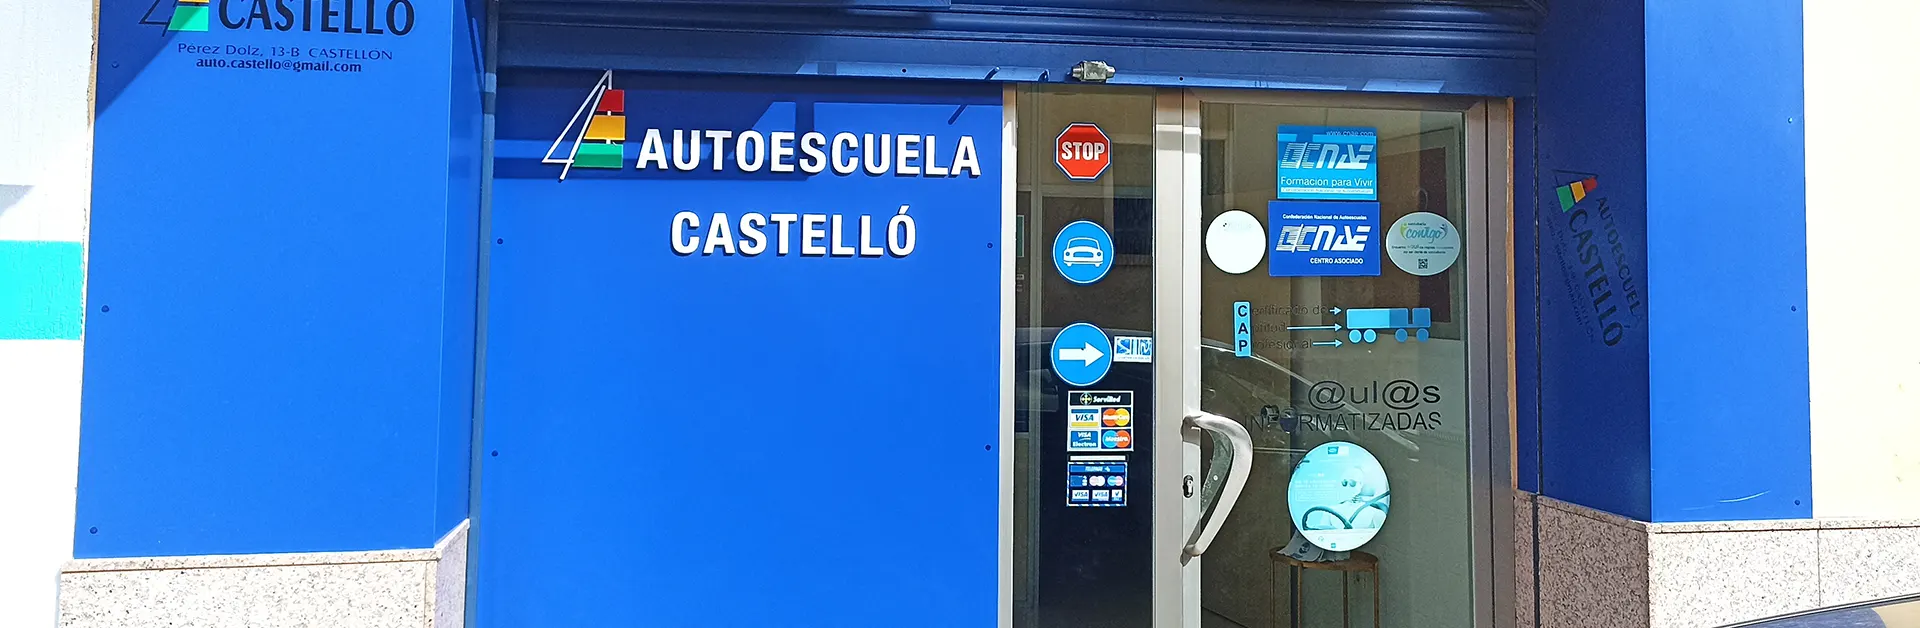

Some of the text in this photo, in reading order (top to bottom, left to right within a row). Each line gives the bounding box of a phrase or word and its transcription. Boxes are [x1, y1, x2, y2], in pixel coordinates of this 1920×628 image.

[178, 43, 220, 54] Pérez
[226, 45, 263, 57] Dolz,
[271, 46, 300, 57] 13-B
[196, 58, 362, 72] auto.castello@gmail.com
[636, 129, 982, 176] AUTOESCUELA
[1061, 141, 1105, 161] STOP
[1332, 178, 1352, 187] para
[1354, 177, 1373, 187] Vivir
[671, 206, 917, 256] CASTELLÓ
[1308, 380, 1442, 410] @ul@s
